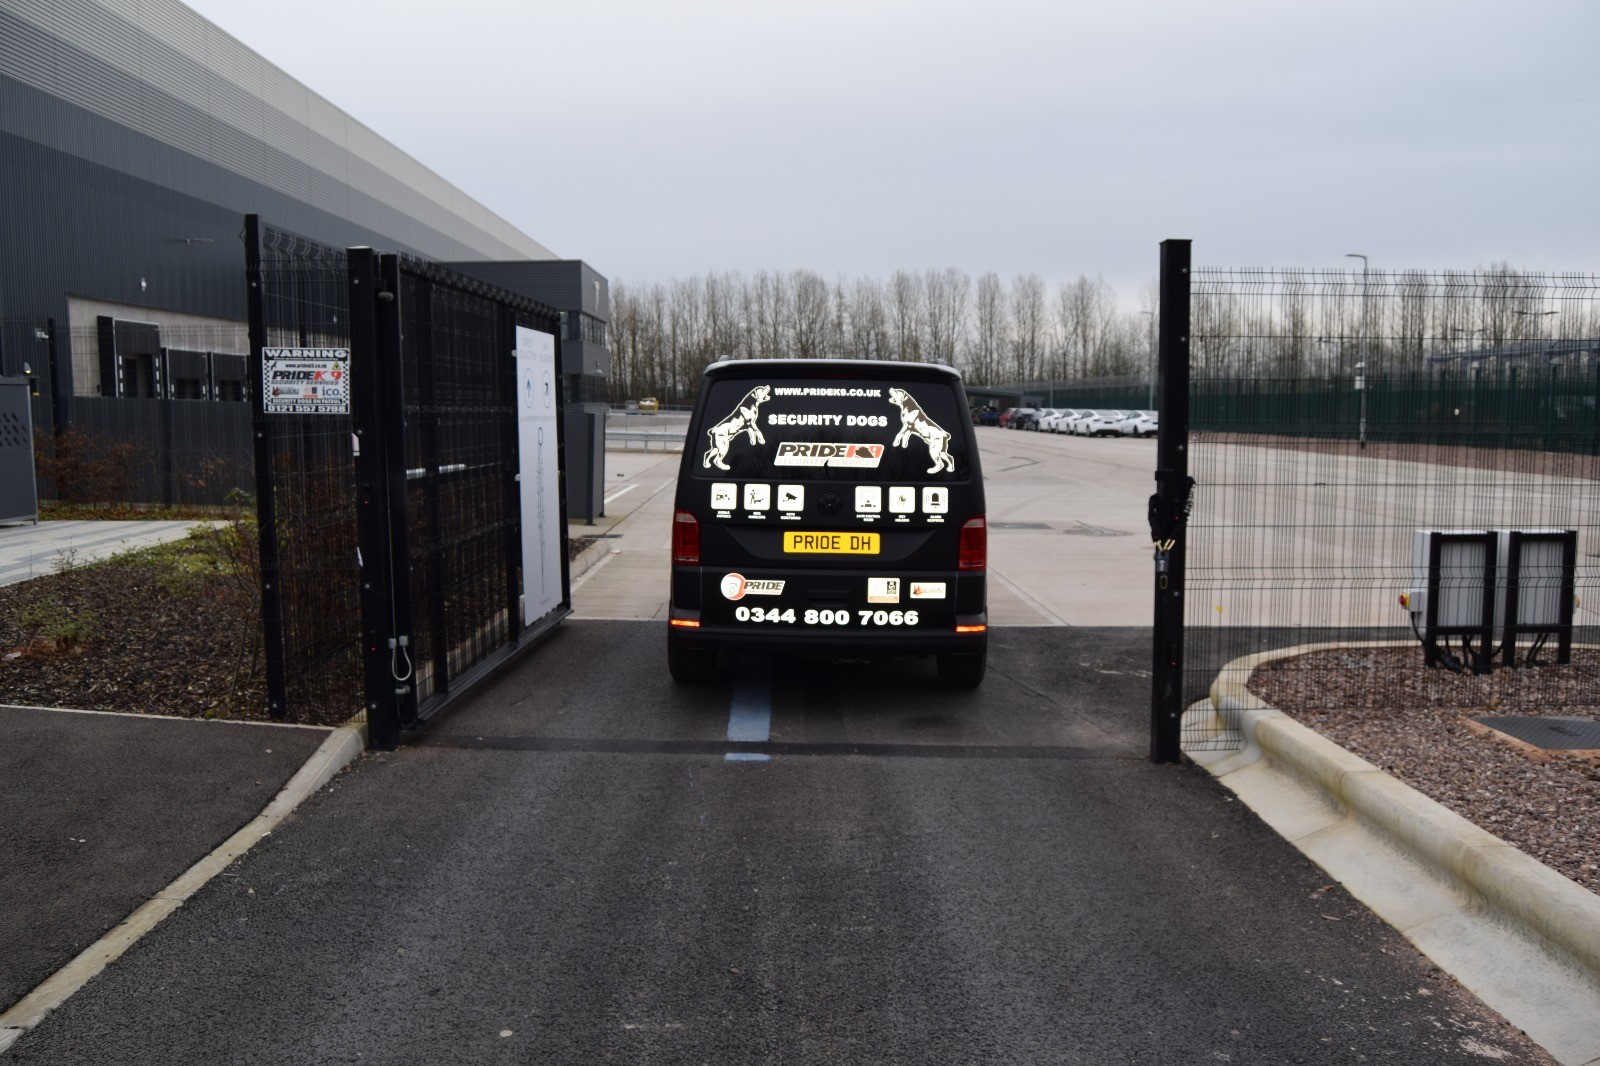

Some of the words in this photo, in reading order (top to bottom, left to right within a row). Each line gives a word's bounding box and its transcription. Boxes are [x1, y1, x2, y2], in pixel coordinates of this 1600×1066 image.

[265, 349, 347, 358] WARNING
[774, 387, 881, 397] WWW.PRIDEK9.CO.UK
[768, 414, 842, 426] SECURITY
[847, 415, 888, 427] DOGS
[850, 536, 871, 550] DH
[743, 581, 784, 590] PRIDE
[735, 606, 797, 624] 0344
[804, 609, 850, 626] 800
[858, 610, 919, 626] 7066
